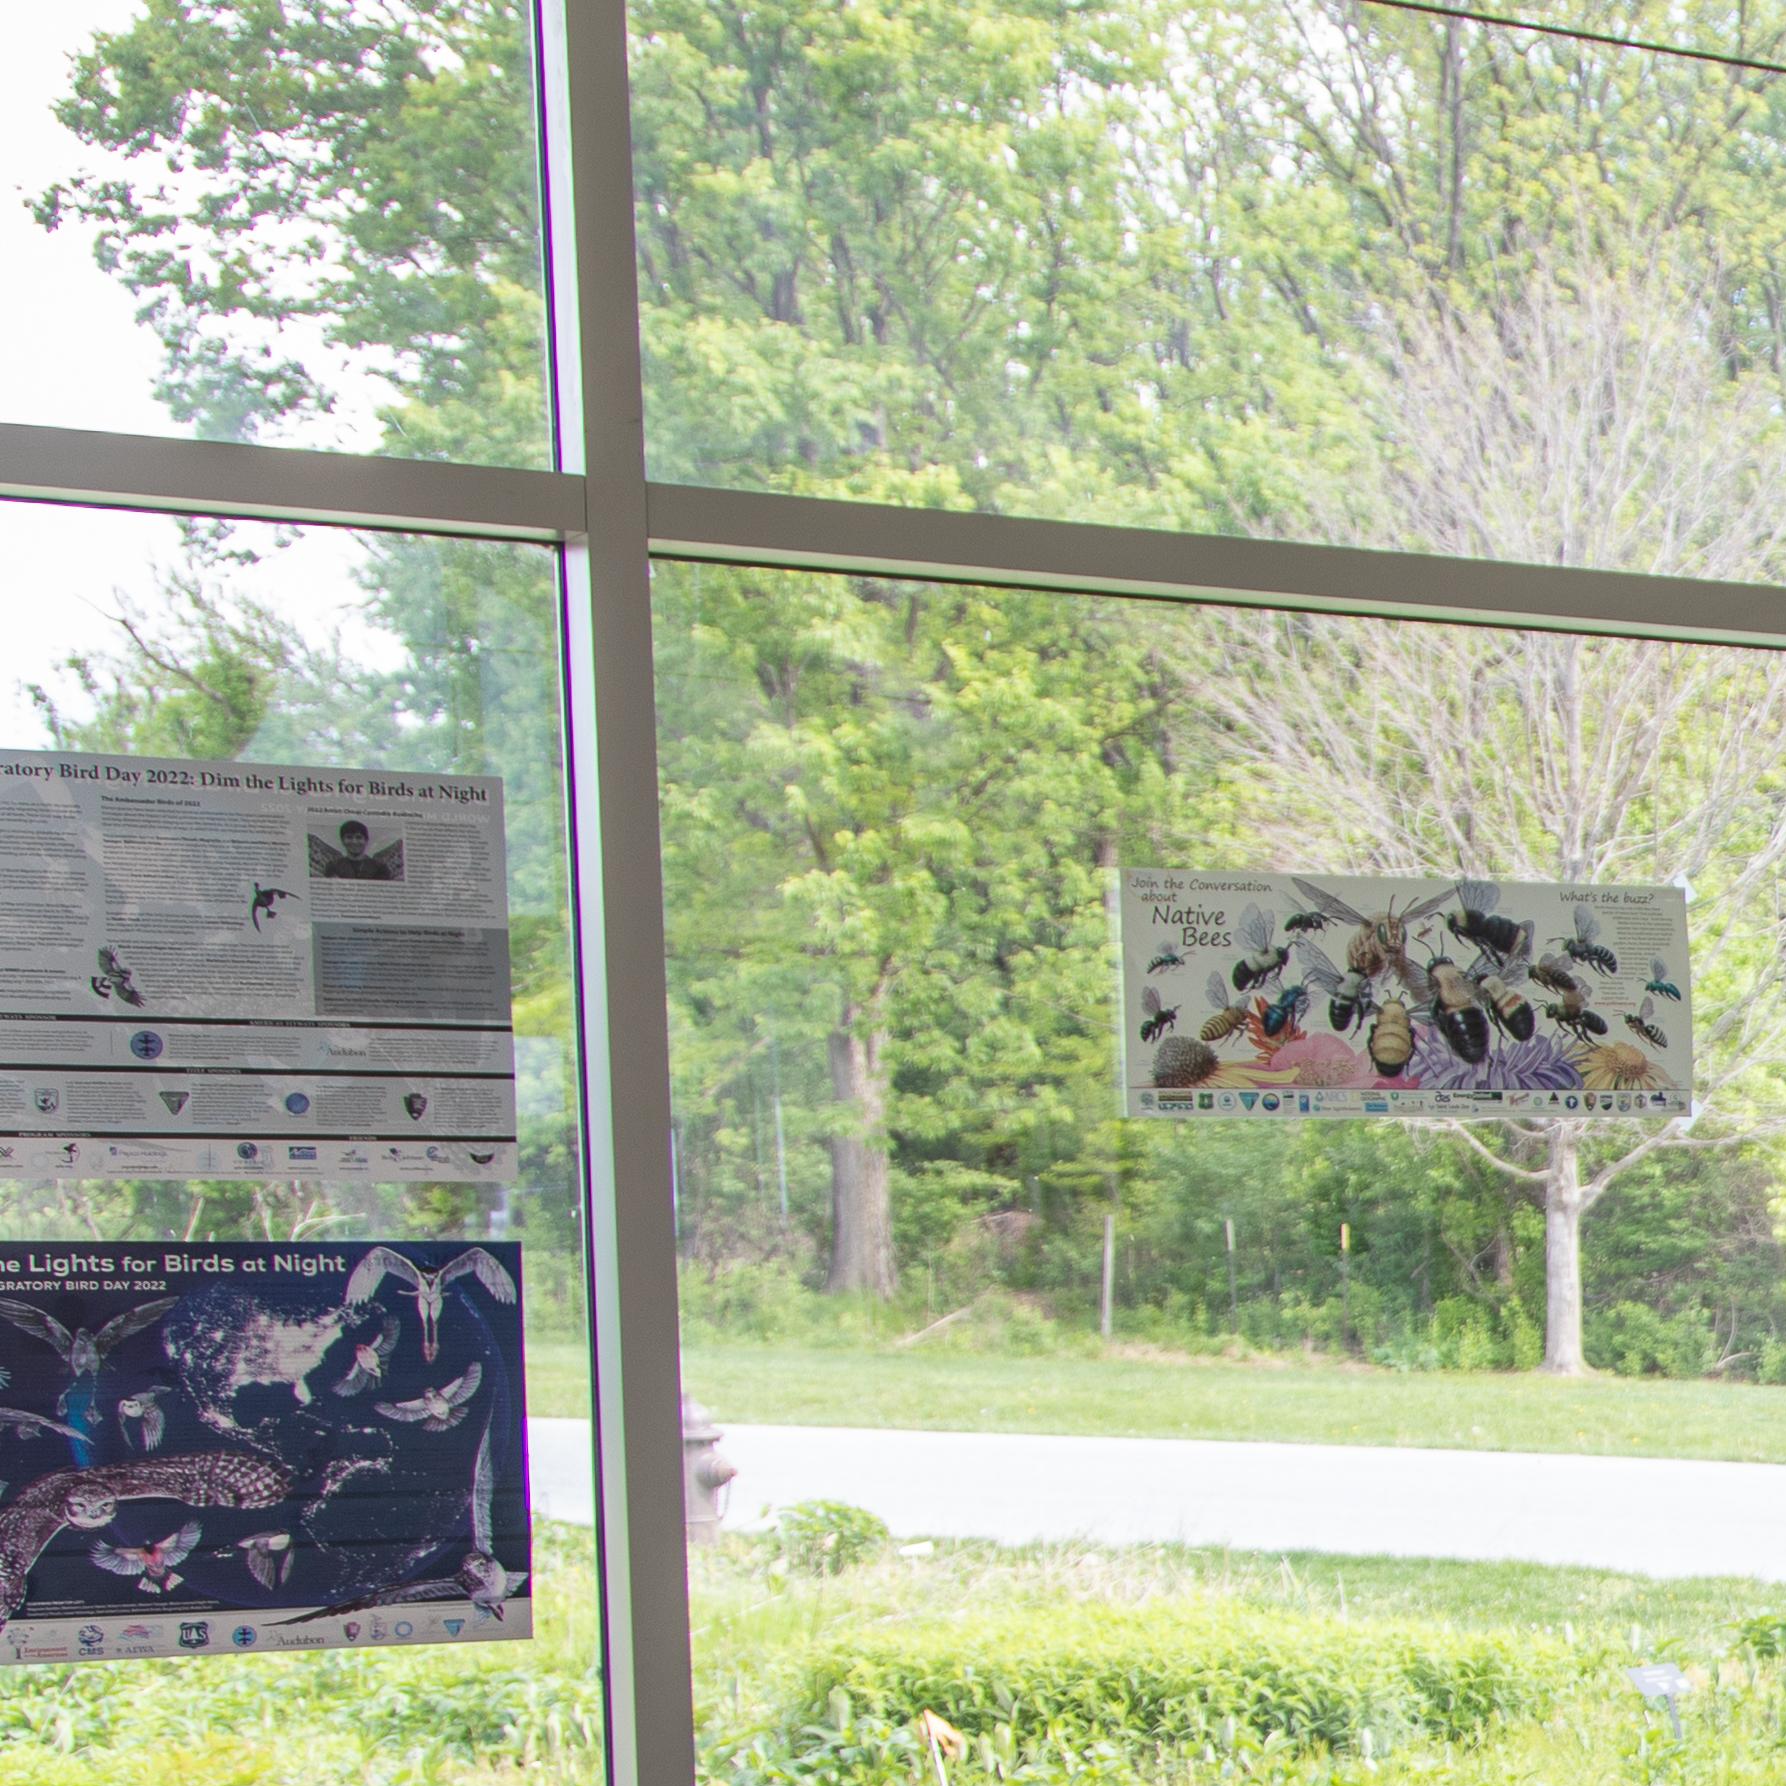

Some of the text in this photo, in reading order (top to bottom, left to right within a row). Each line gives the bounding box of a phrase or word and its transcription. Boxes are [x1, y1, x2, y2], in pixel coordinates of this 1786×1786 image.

[0, 763, 488, 803] atory Bird Day 2022: Dim the Lights for Birds at Night
[1131, 877, 1272, 892] Join the Conversation
[1141, 890, 1178, 903] about
[1601, 892, 1619, 903] the
[1623, 892, 1655, 904] buzz?
[1152, 904, 1226, 926] Native
[1182, 926, 1232, 947] Bees
[29, 1254, 114, 1277] Lights
[121, 1256, 156, 1272] for
[164, 1254, 234, 1272] Birds
[242, 1258, 266, 1272] at
[274, 1254, 345, 1276] Night
[65, 1281, 99, 1291] BIRD
[103, 1281, 129, 1291] DAY
[134, 1281, 167, 1290] 2022
